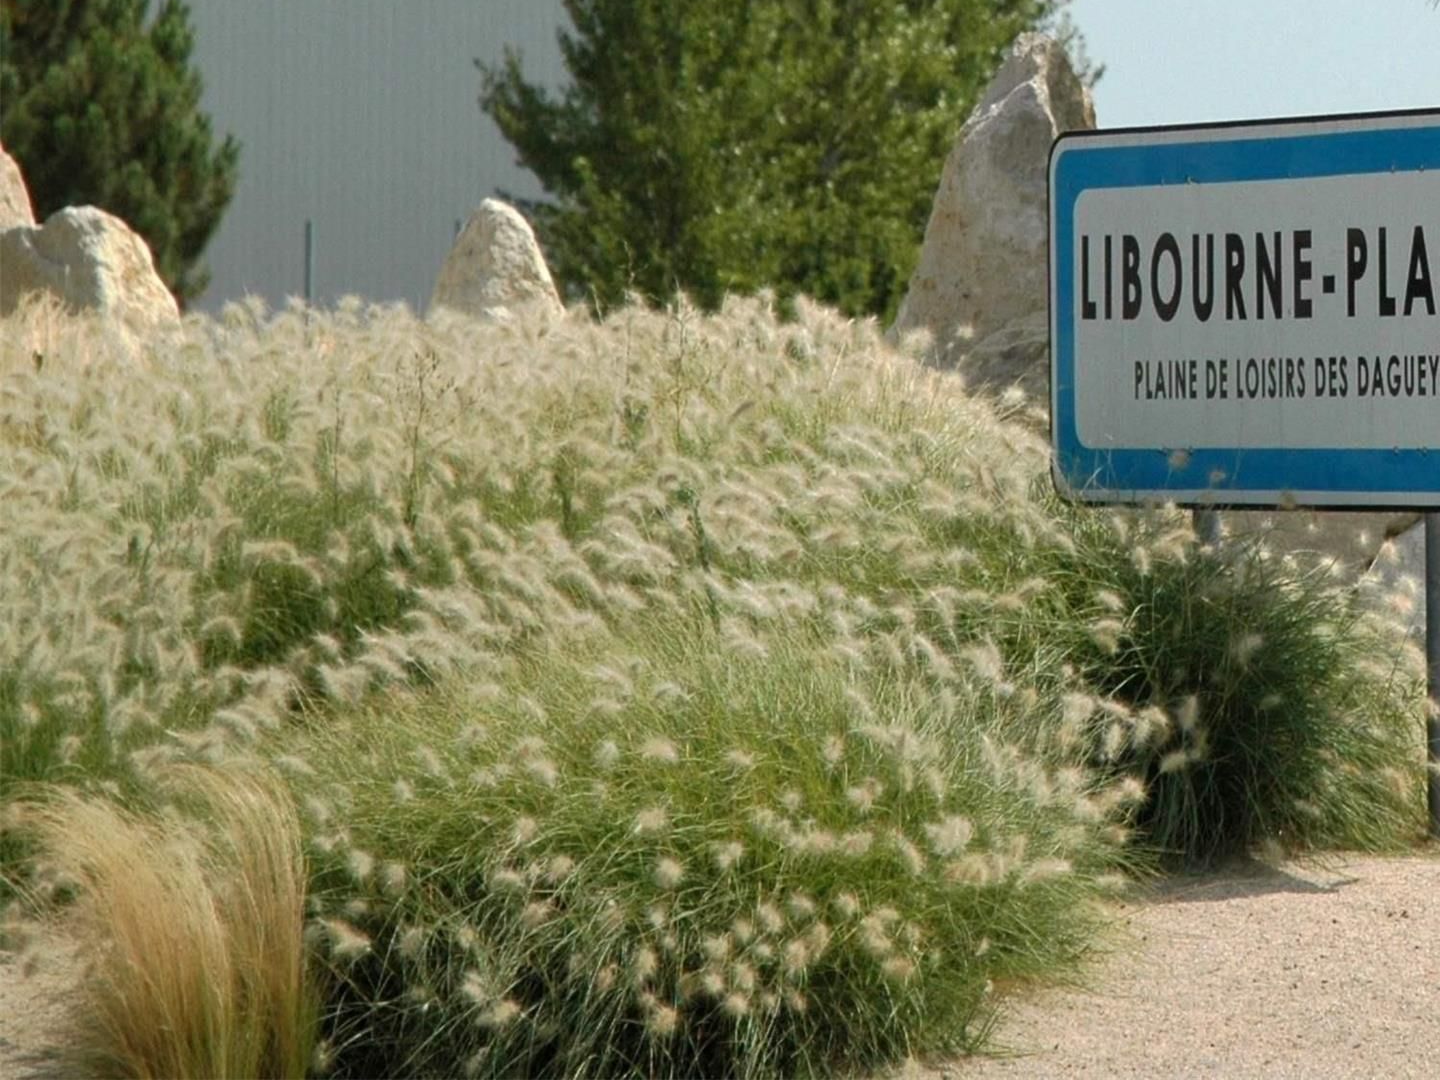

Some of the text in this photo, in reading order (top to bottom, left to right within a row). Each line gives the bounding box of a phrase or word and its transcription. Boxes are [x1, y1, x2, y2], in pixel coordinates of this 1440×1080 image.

[1134, 360, 1198, 400] PLAINE
[1206, 359, 1229, 400] DE
[1236, 357, 1306, 400] LOISIRS
[1315, 356, 1349, 399] DES
